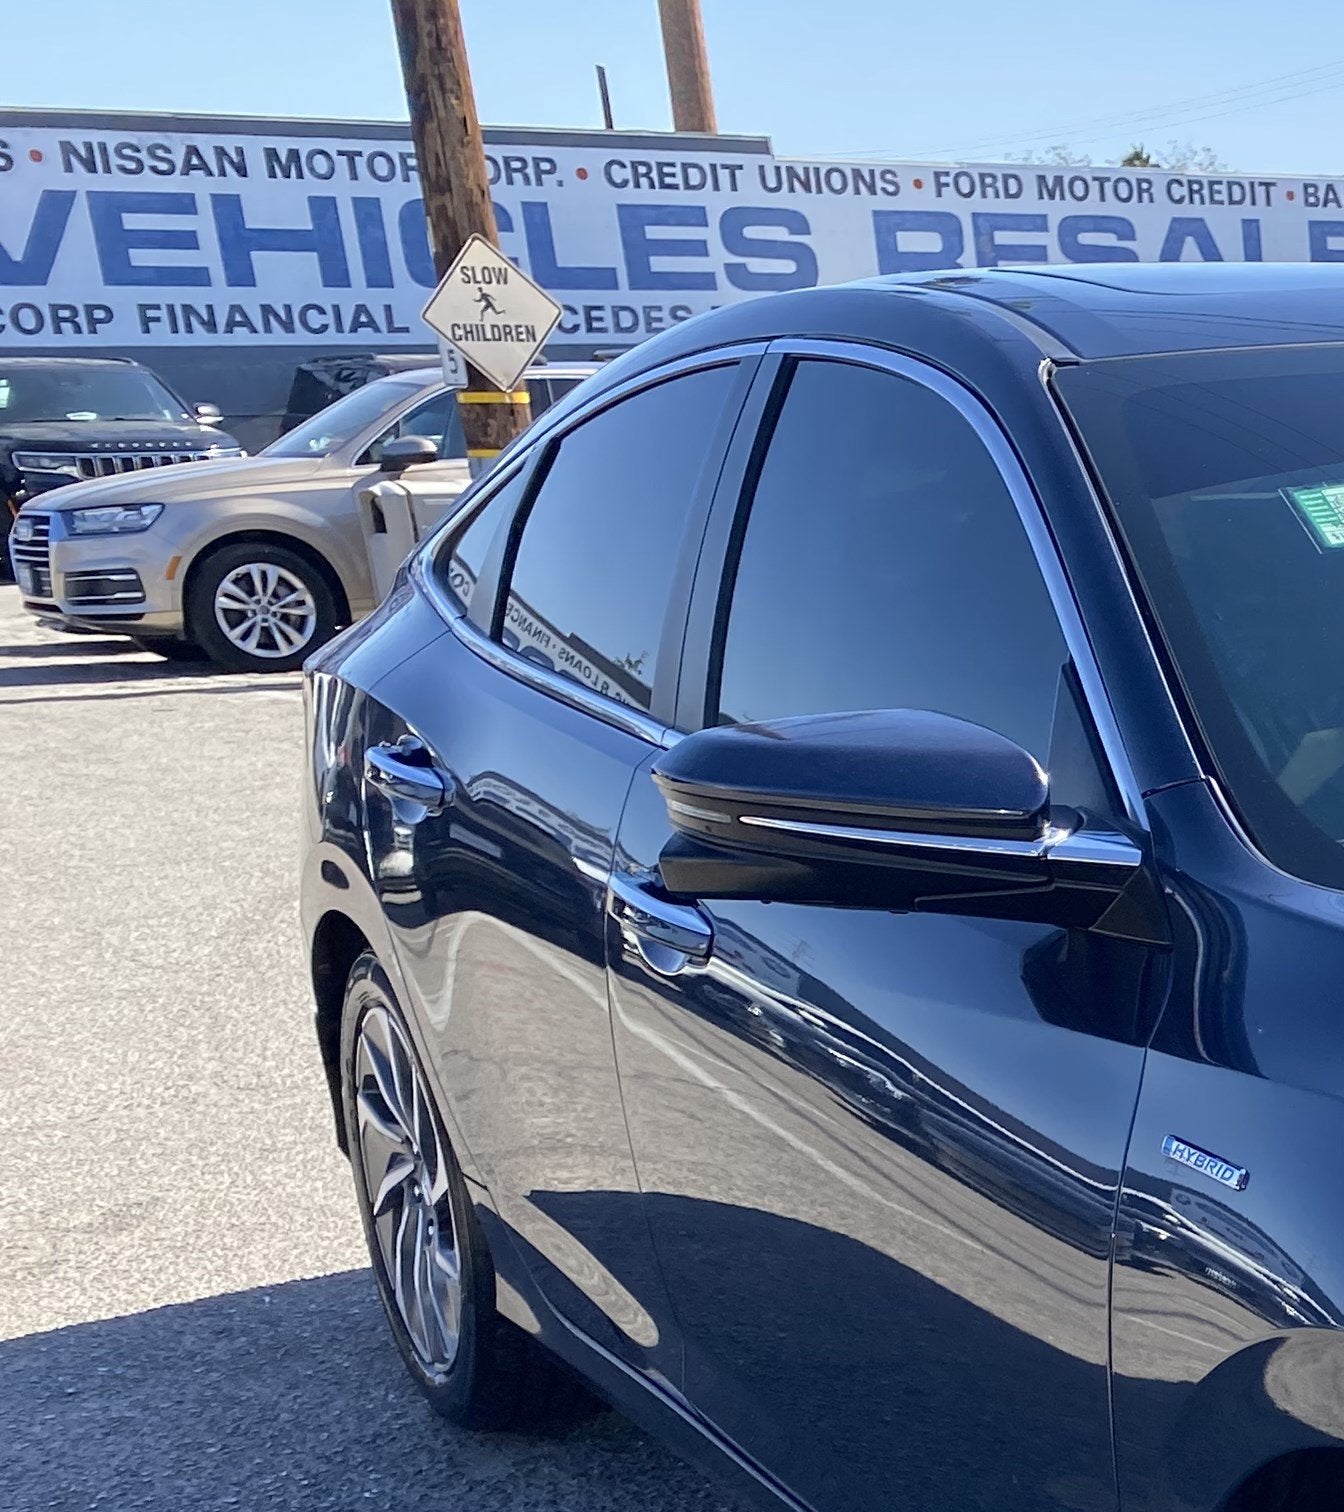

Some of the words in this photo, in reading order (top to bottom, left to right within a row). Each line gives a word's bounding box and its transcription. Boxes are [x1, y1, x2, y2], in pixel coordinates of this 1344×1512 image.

[58, 140, 248, 178] NISSAN
[263, 146, 419, 183] MOTOR
[484, 154, 564, 188] ORP.
[603, 158, 744, 193] CREDIT
[758, 164, 901, 197] UNIONS
[933, 170, 1023, 199] FORD
[1035, 174, 1155, 204] MOTOR
[1166, 178, 1277, 207] CREDIT
[460, 265, 509, 285] SLOW
[0, 302, 114, 335] ORP
[136, 303, 411, 335] FINANCIAL
[556, 304, 693, 335] CEDES
[451, 322, 537, 342] CHILDREN
[1172, 1143, 1235, 1182] HYBRID
